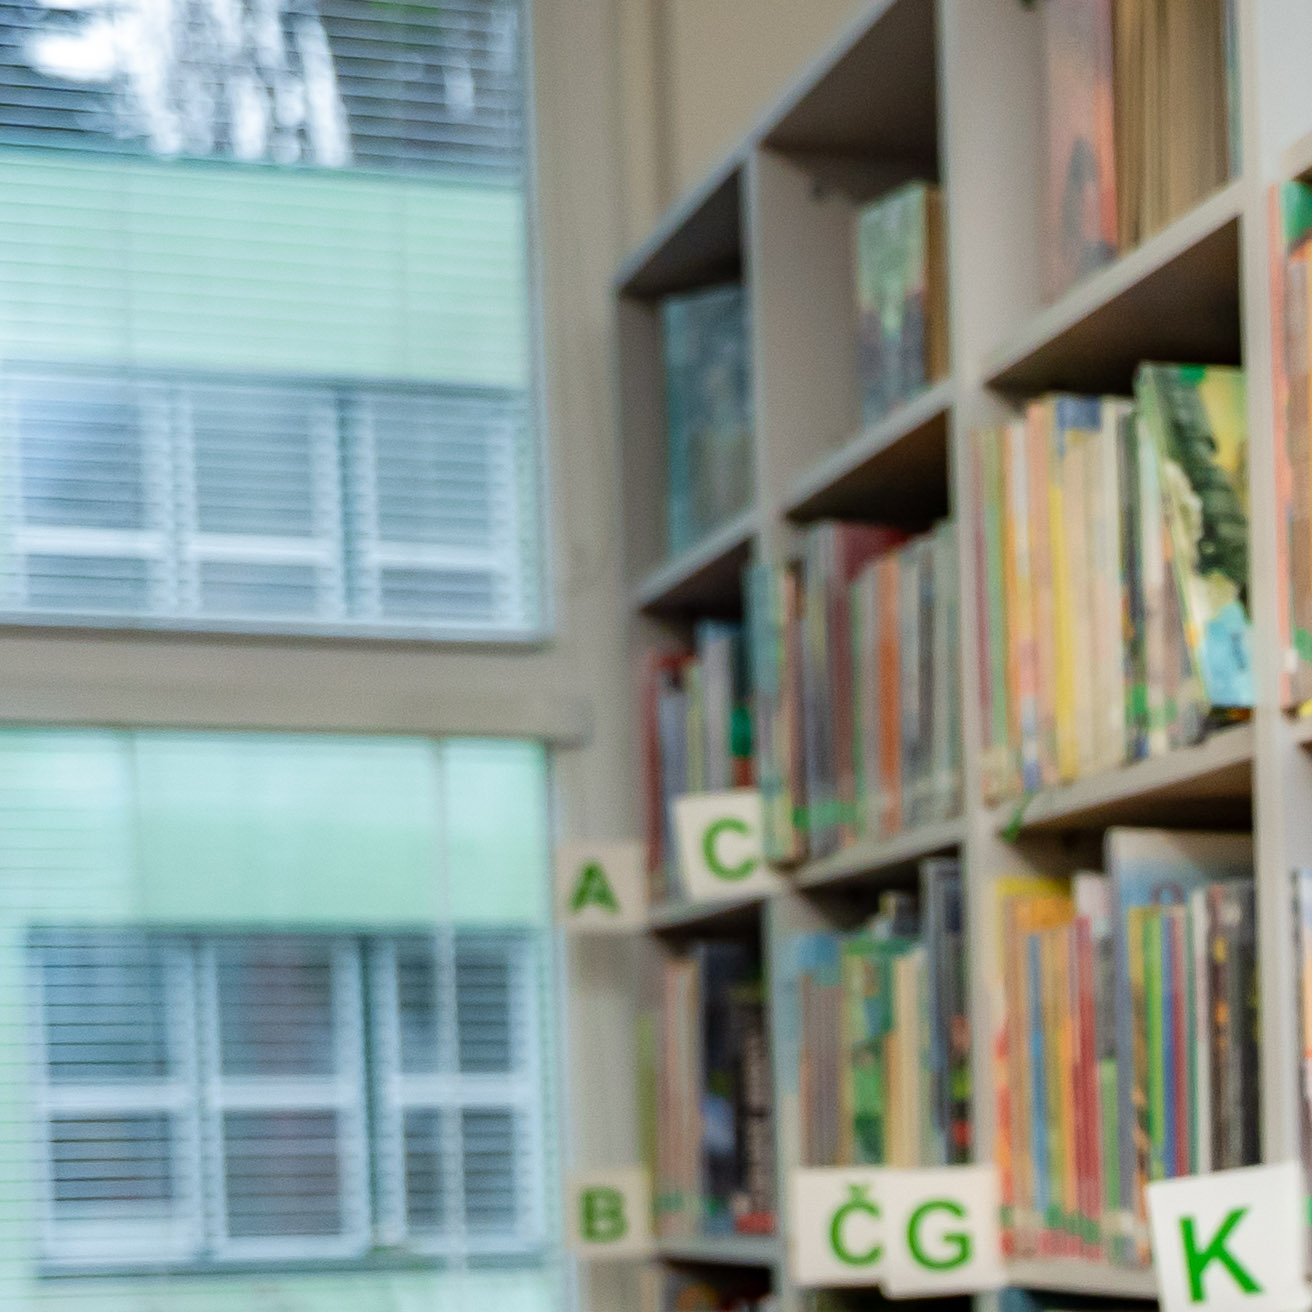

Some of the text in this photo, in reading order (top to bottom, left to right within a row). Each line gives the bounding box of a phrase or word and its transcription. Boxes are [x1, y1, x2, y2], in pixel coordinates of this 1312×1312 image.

[700, 817, 761, 882] C
[568, 862, 621, 914] A
[579, 1186, 628, 1242] B
[904, 1199, 974, 1272] G
[1177, 1207, 1266, 1305] K
